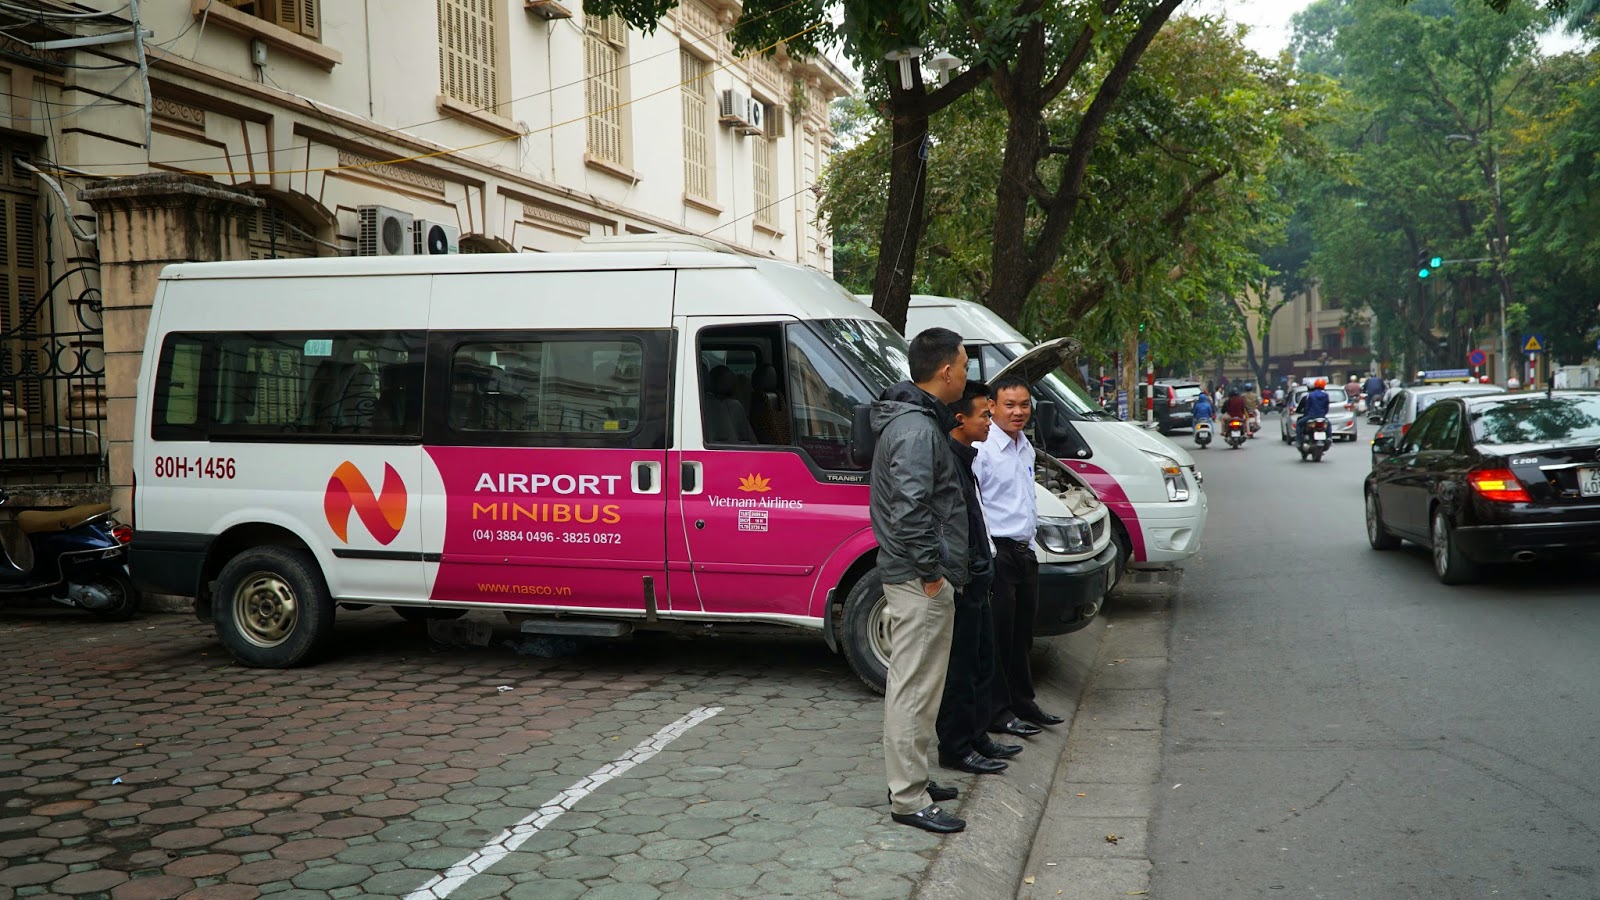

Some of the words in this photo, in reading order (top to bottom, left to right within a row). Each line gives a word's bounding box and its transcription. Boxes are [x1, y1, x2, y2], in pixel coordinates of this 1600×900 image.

[154, 456, 236, 480] 80H-1456
[474, 472, 622, 495] AIRPORT
[1584, 481, 1600, 493] 40
[708, 495, 757, 508] Vietnam
[758, 496, 803, 509] Airlines
[472, 502, 621, 524] MINIBUS
[472, 529, 494, 542] (04)
[496, 530, 524, 542] 3884
[526, 531, 554, 543] 0496
[562, 532, 590, 544] 3825
[593, 533, 622, 544] 0872
[477, 582, 572, 596] www.nasco.vn
